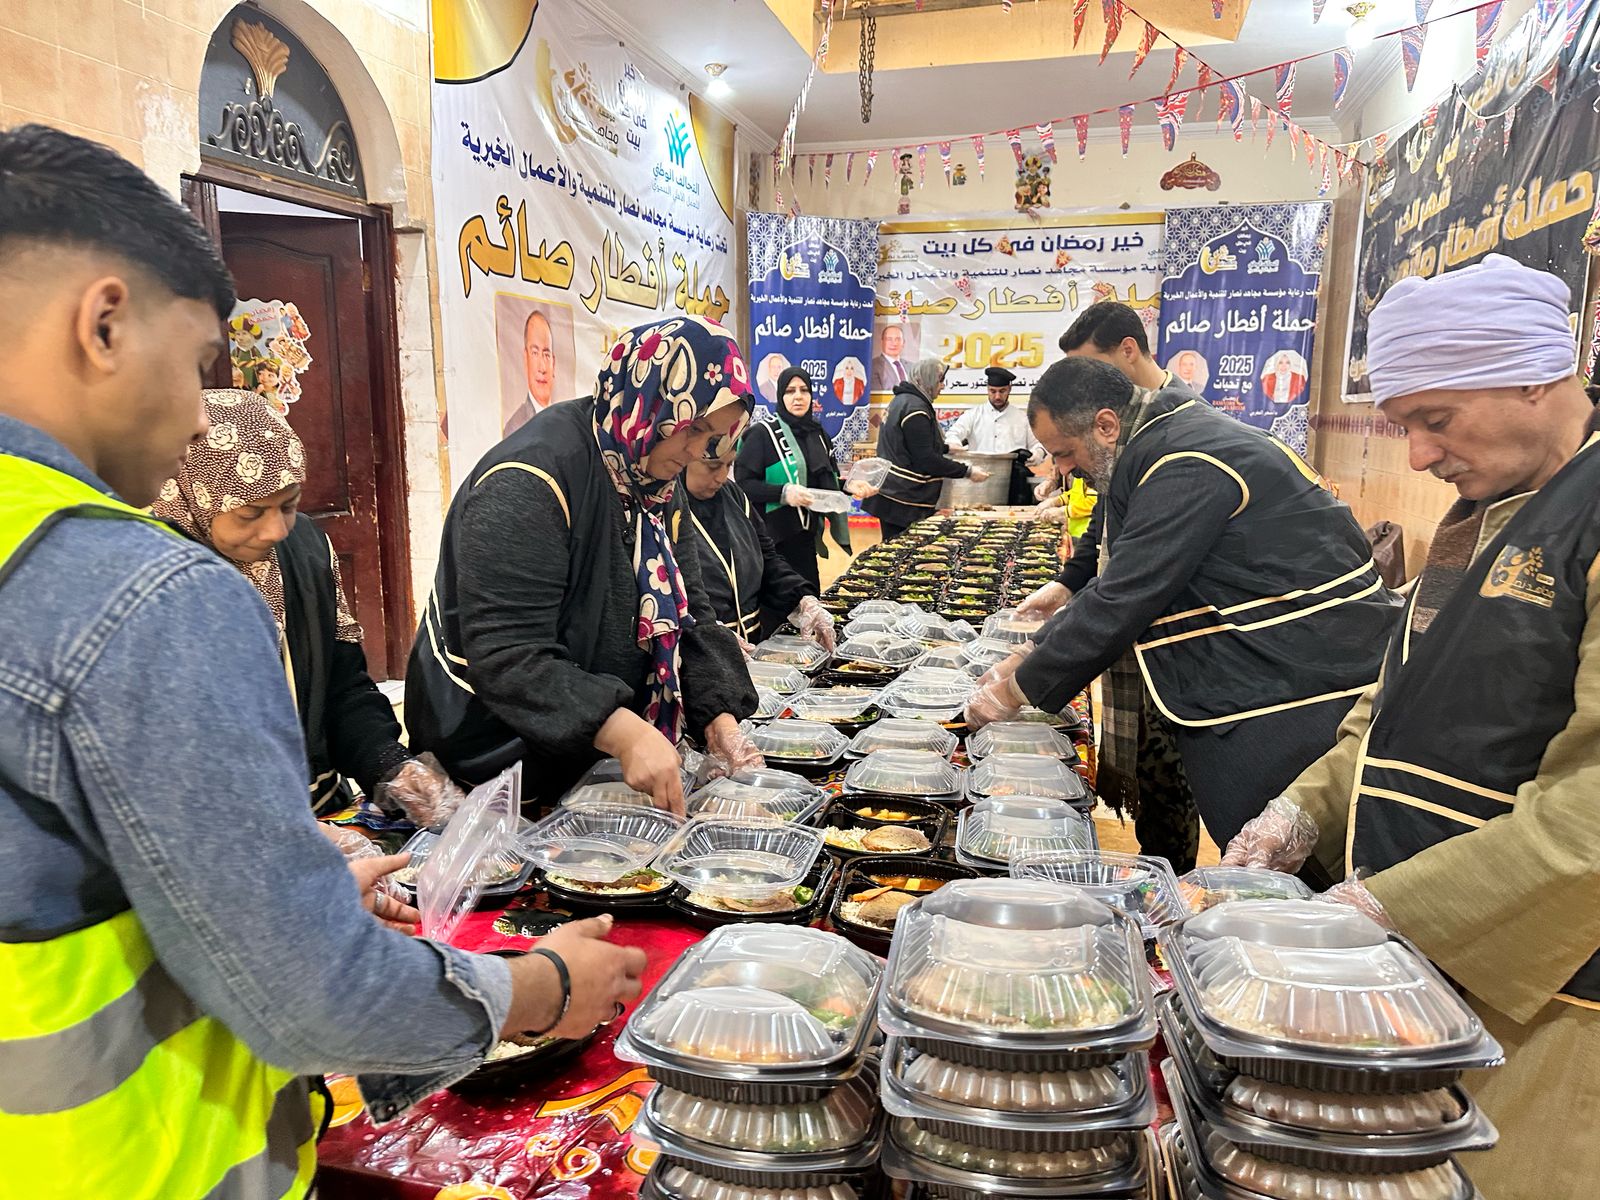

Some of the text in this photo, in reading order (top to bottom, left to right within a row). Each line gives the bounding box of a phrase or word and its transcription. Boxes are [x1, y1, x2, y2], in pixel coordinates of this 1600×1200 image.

[460, 121, 728, 254] تحت رعاية مؤسسة مجاهد نصار للتنمية والأعمال الخيرية
[1502, 170, 1596, 241] حملة
[923, 240, 957, 258] بيت
[963, 237, 993, 255] كل
[1041, 234, 1104, 253] رمضان
[1111, 232, 1144, 252] خير
[458, 194, 731, 322] حملة أفطار صائم
[1090, 264, 1137, 275] مؤسسة
[960, 280, 1079, 321] أفطار
[755, 312, 873, 346] حملة أفطار صائم
[1165, 304, 1316, 344] حملة أفطار صائم
[938, 331, 1045, 369] 2025
[801, 360, 827, 379] 2025
[1219, 355, 1254, 376] 2025
[819, 384, 828, 396] مع
[1213, 378, 1253, 394] مع تحيات
